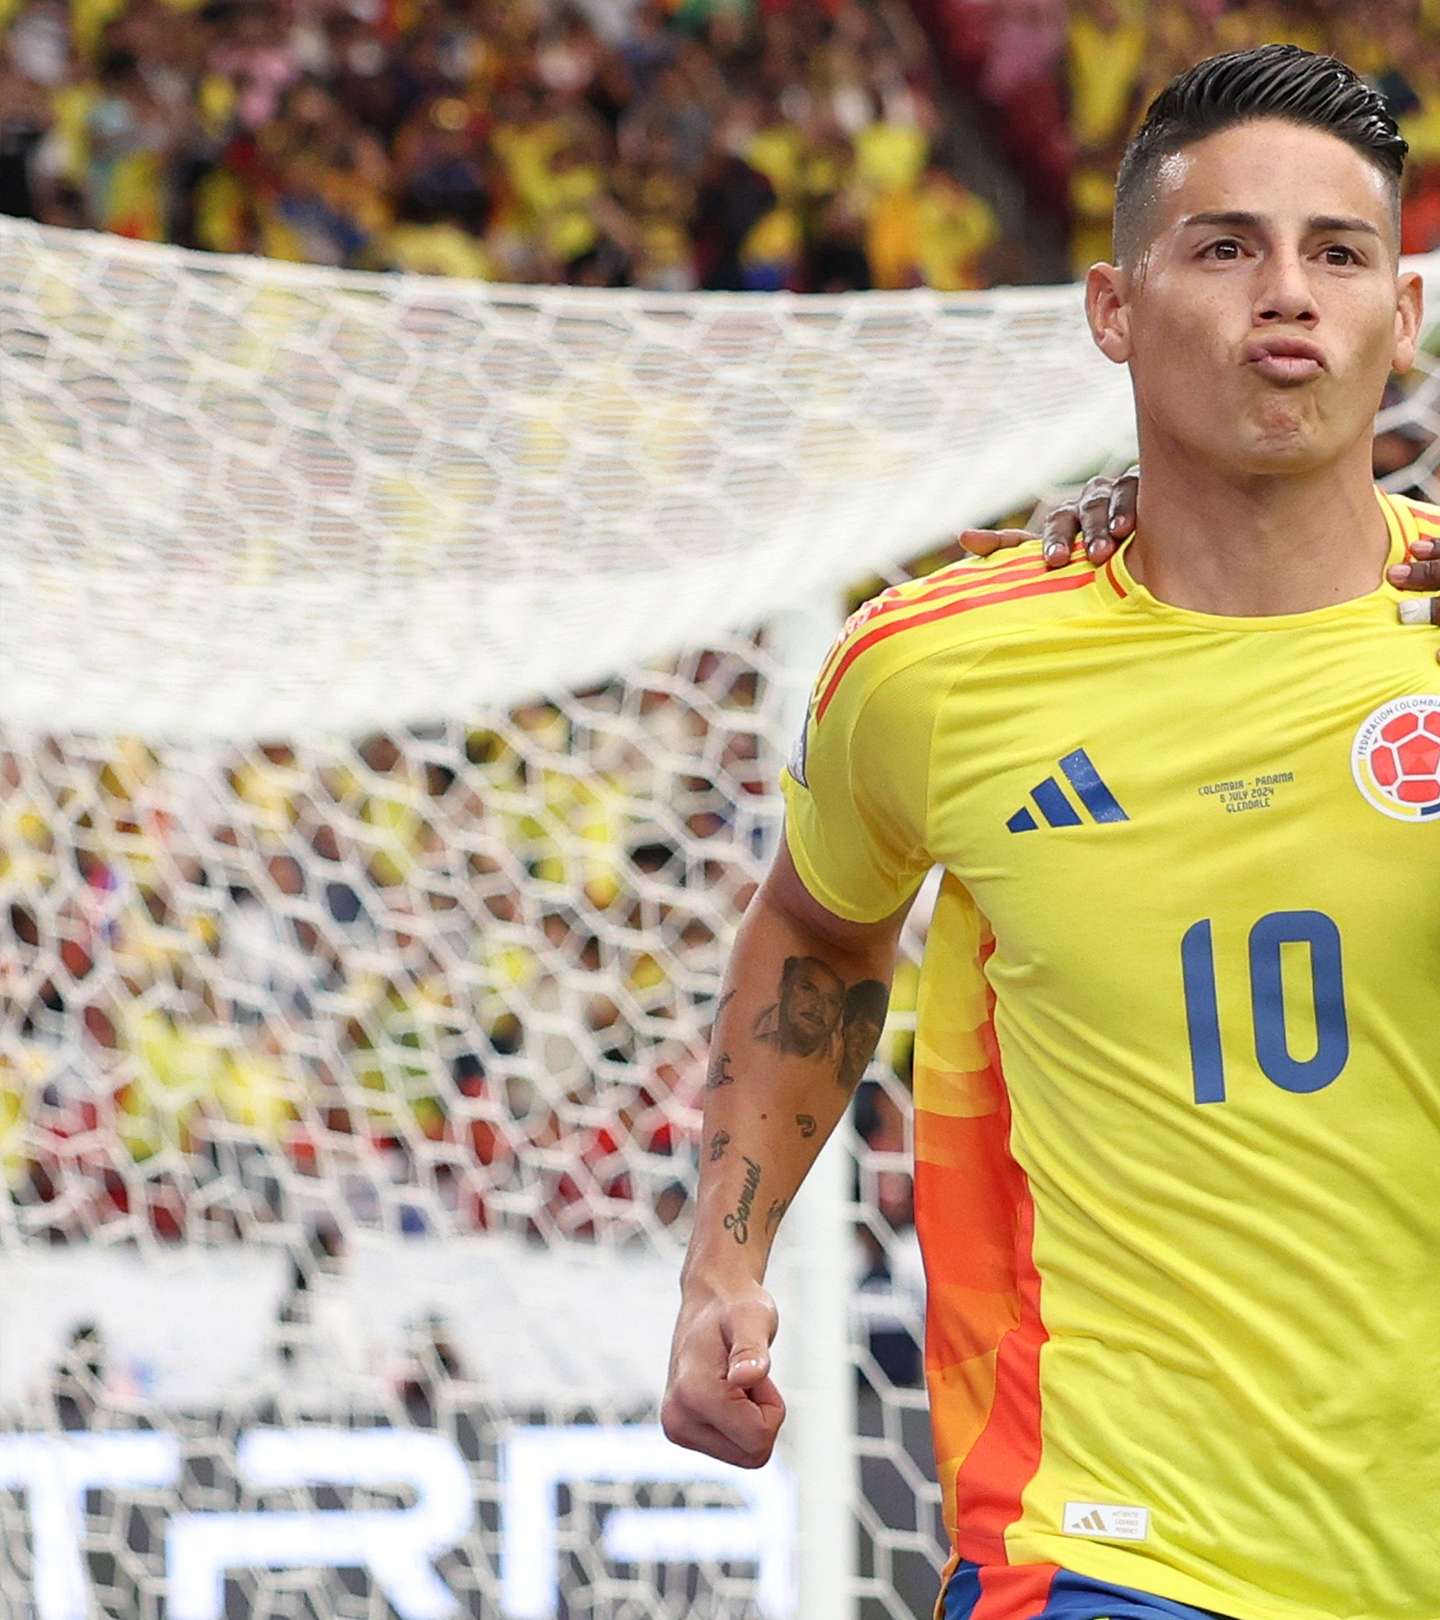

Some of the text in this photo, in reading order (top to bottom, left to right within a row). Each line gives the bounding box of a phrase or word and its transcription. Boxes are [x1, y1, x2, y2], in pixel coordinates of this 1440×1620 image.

[1198, 780, 1245, 797] COLOMBIA
[1255, 771, 1295, 787] PANAMA
[1228, 790, 1248, 803] JULY
[1251, 786, 1275, 799] 2024
[1226, 797, 1271, 813] GLENDALE
[1181, 910, 1349, 1105] 10
[723, 1156, 761, 1245] Samuel
